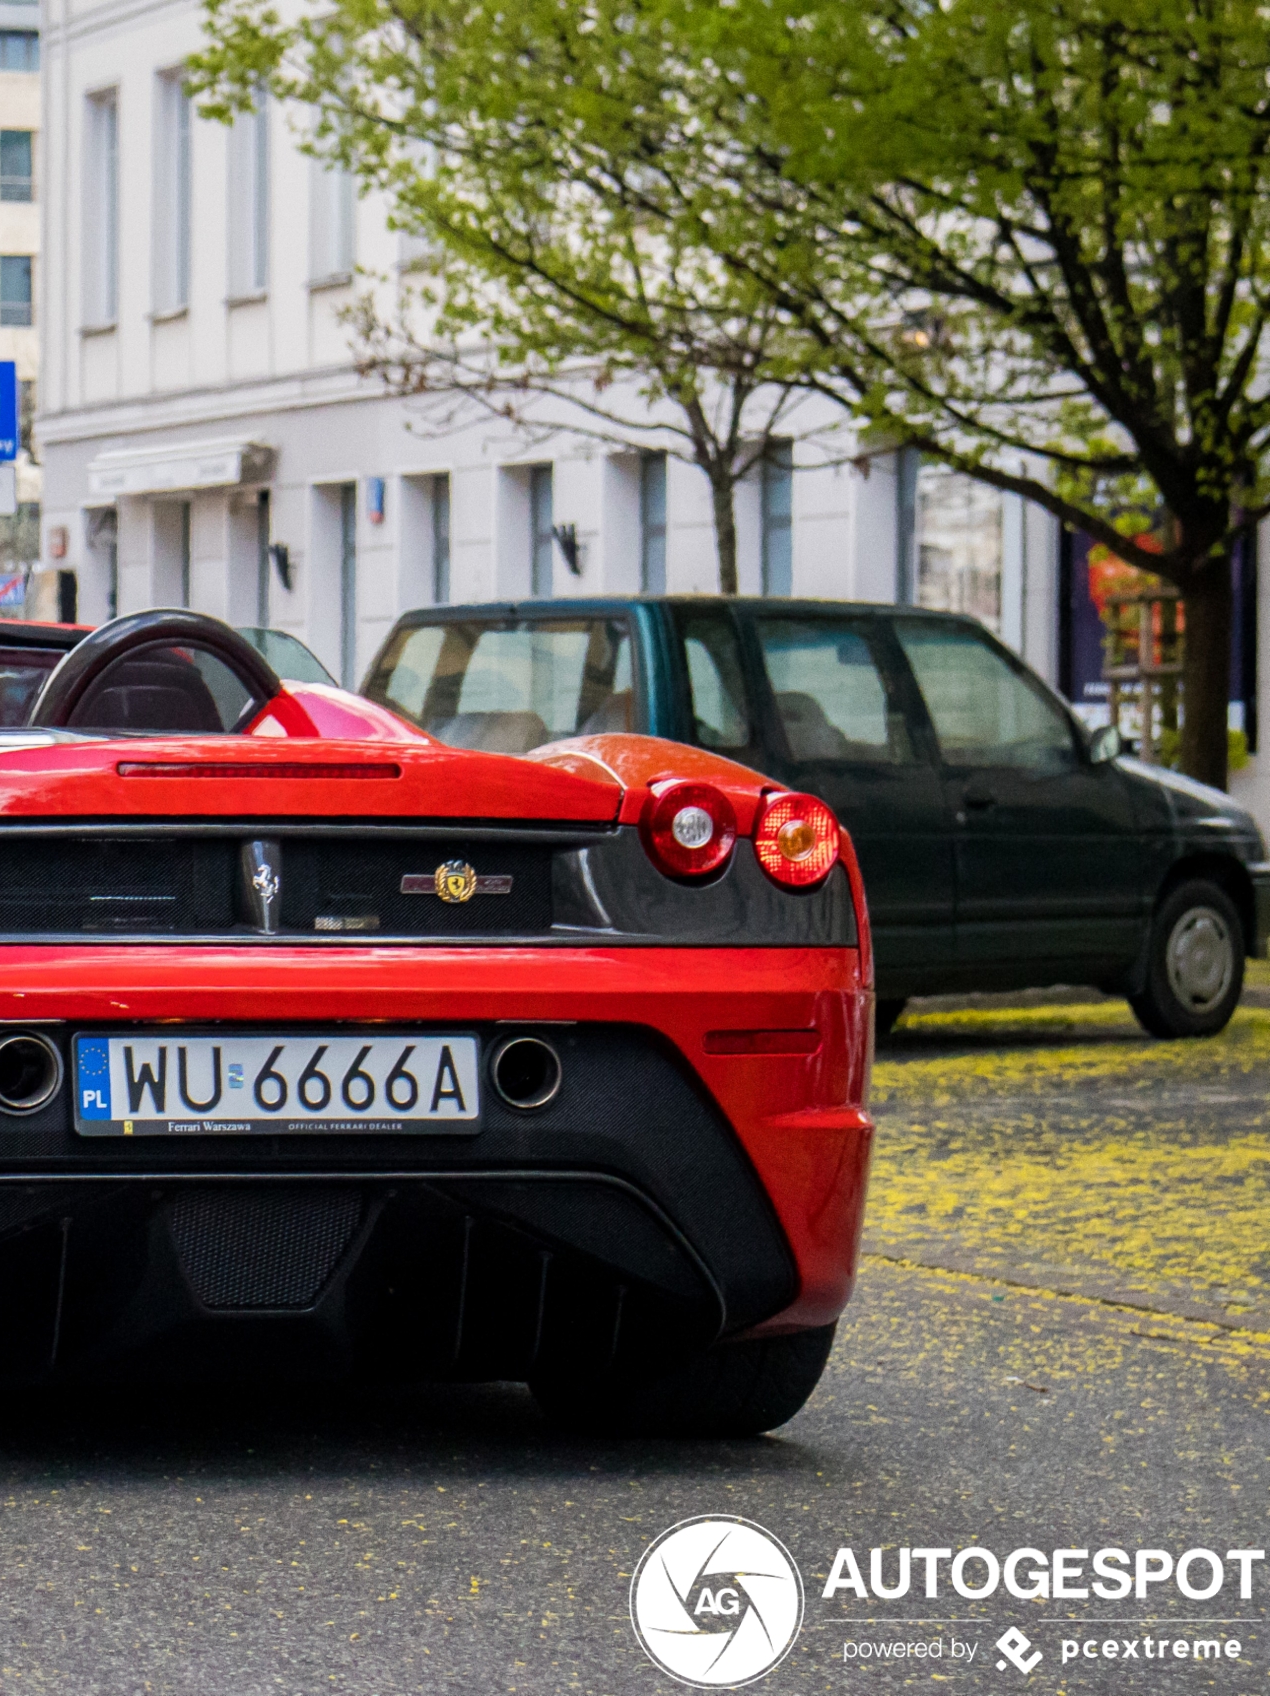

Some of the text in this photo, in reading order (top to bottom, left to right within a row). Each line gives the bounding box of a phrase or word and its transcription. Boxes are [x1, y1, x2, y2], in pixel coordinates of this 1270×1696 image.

[123, 1044, 467, 1114] WU 6666A
[83, 1089, 108, 1109] PL
[168, 1121, 252, 1132] Ferrari Warszawa
[288, 1122, 403, 1131] OFFICIAL FERRARI DEALER
